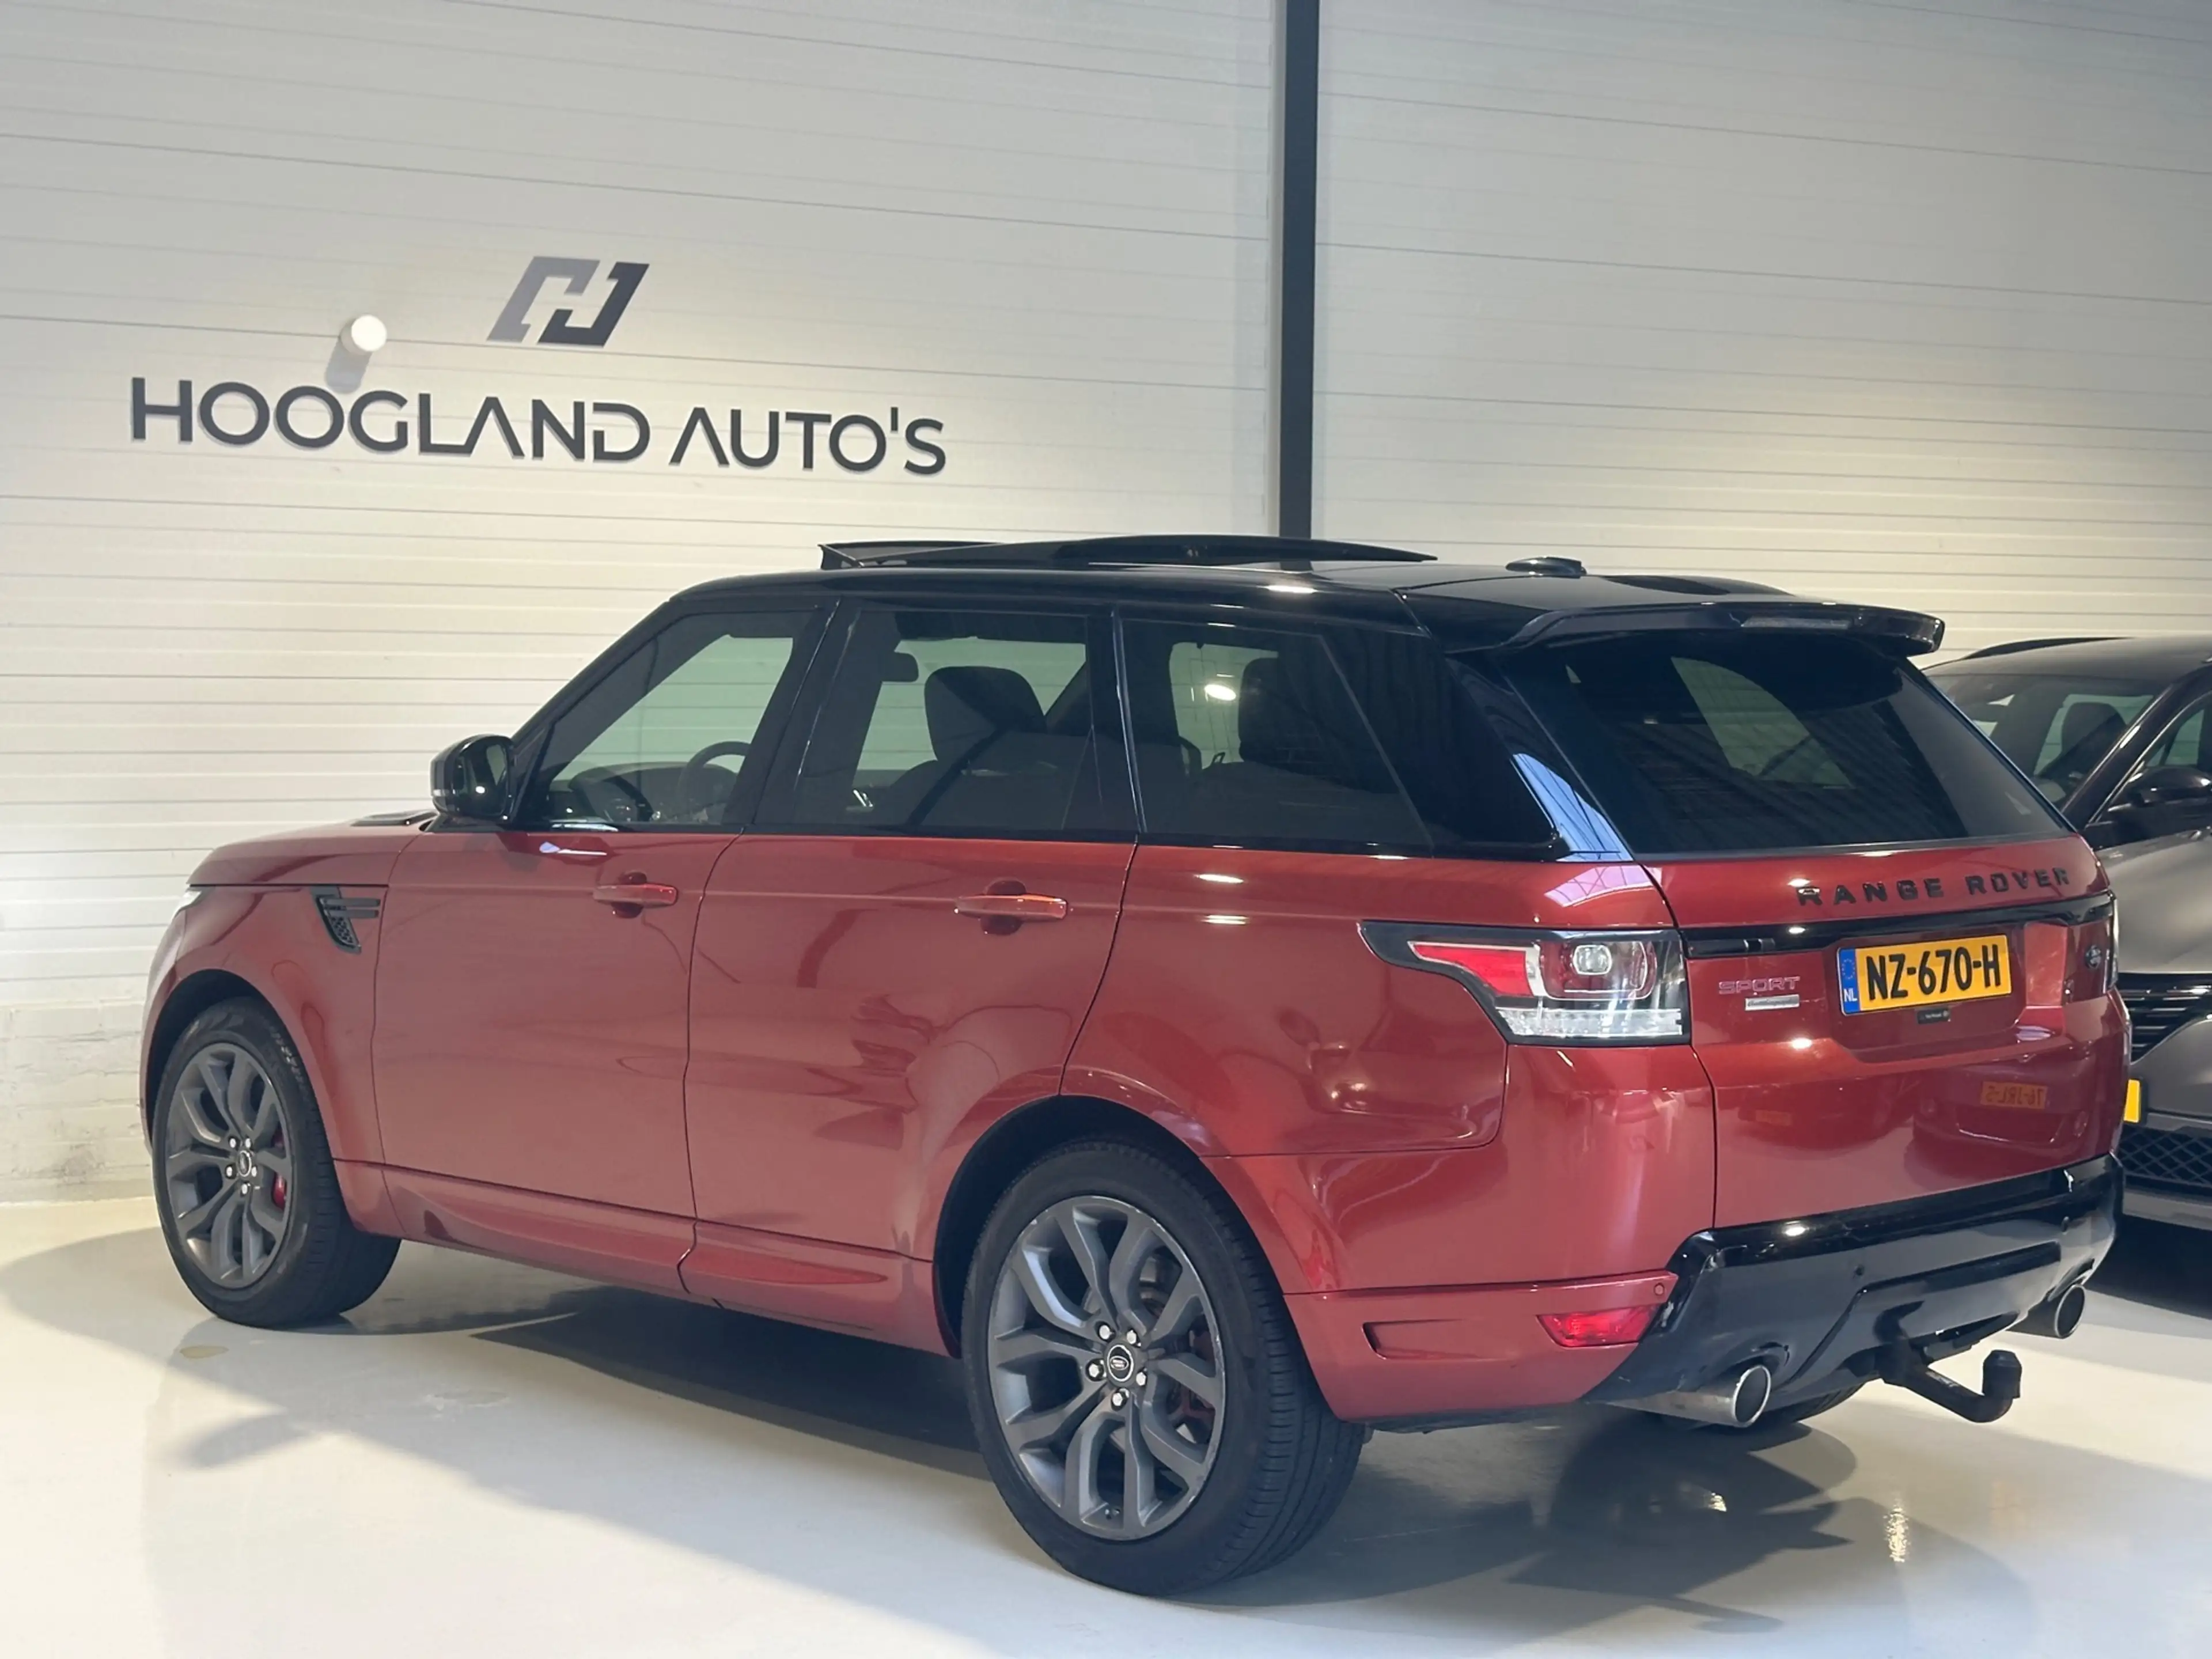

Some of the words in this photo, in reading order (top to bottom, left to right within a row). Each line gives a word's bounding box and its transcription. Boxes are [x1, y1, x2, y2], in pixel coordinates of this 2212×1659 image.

[131, 376, 652, 462] HOOGLAND
[668, 406, 946, 475] AUTO'S
[1797, 877, 1944, 906] RANGE
[1964, 867, 2070, 895] ROVER
[1718, 976, 1801, 995] SPORT
[1866, 944, 2001, 1001] NZ-670-H
[1844, 988, 1857, 1002] NL
